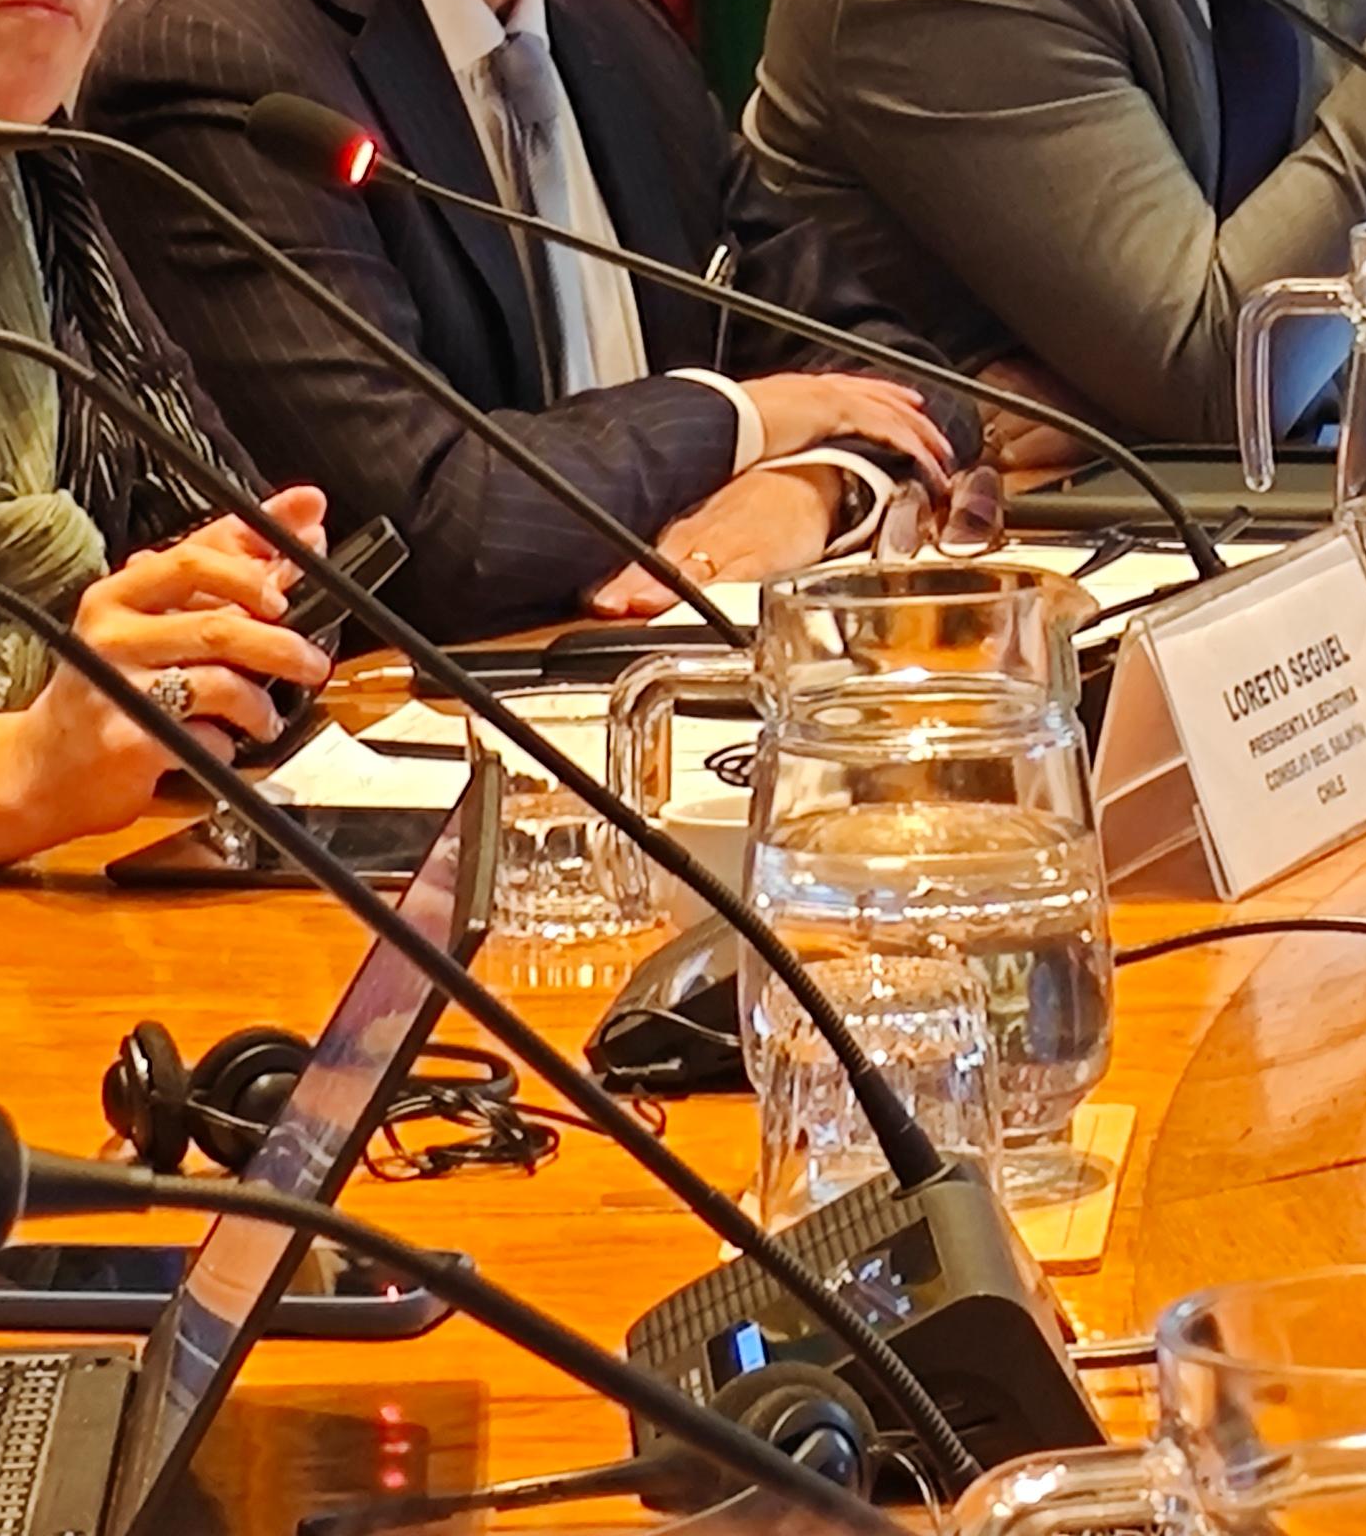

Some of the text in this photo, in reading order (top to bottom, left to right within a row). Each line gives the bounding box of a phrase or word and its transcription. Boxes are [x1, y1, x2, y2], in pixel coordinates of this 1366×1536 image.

[1223, 634, 1351, 722] LORETO SEGUEL
[1249, 685, 1358, 759] PRESIDENTA EJECUTIVA
[1265, 751, 1312, 792] CONSEJO
[1310, 743, 1332, 767] DEL
[1317, 773, 1348, 805] CHILE
